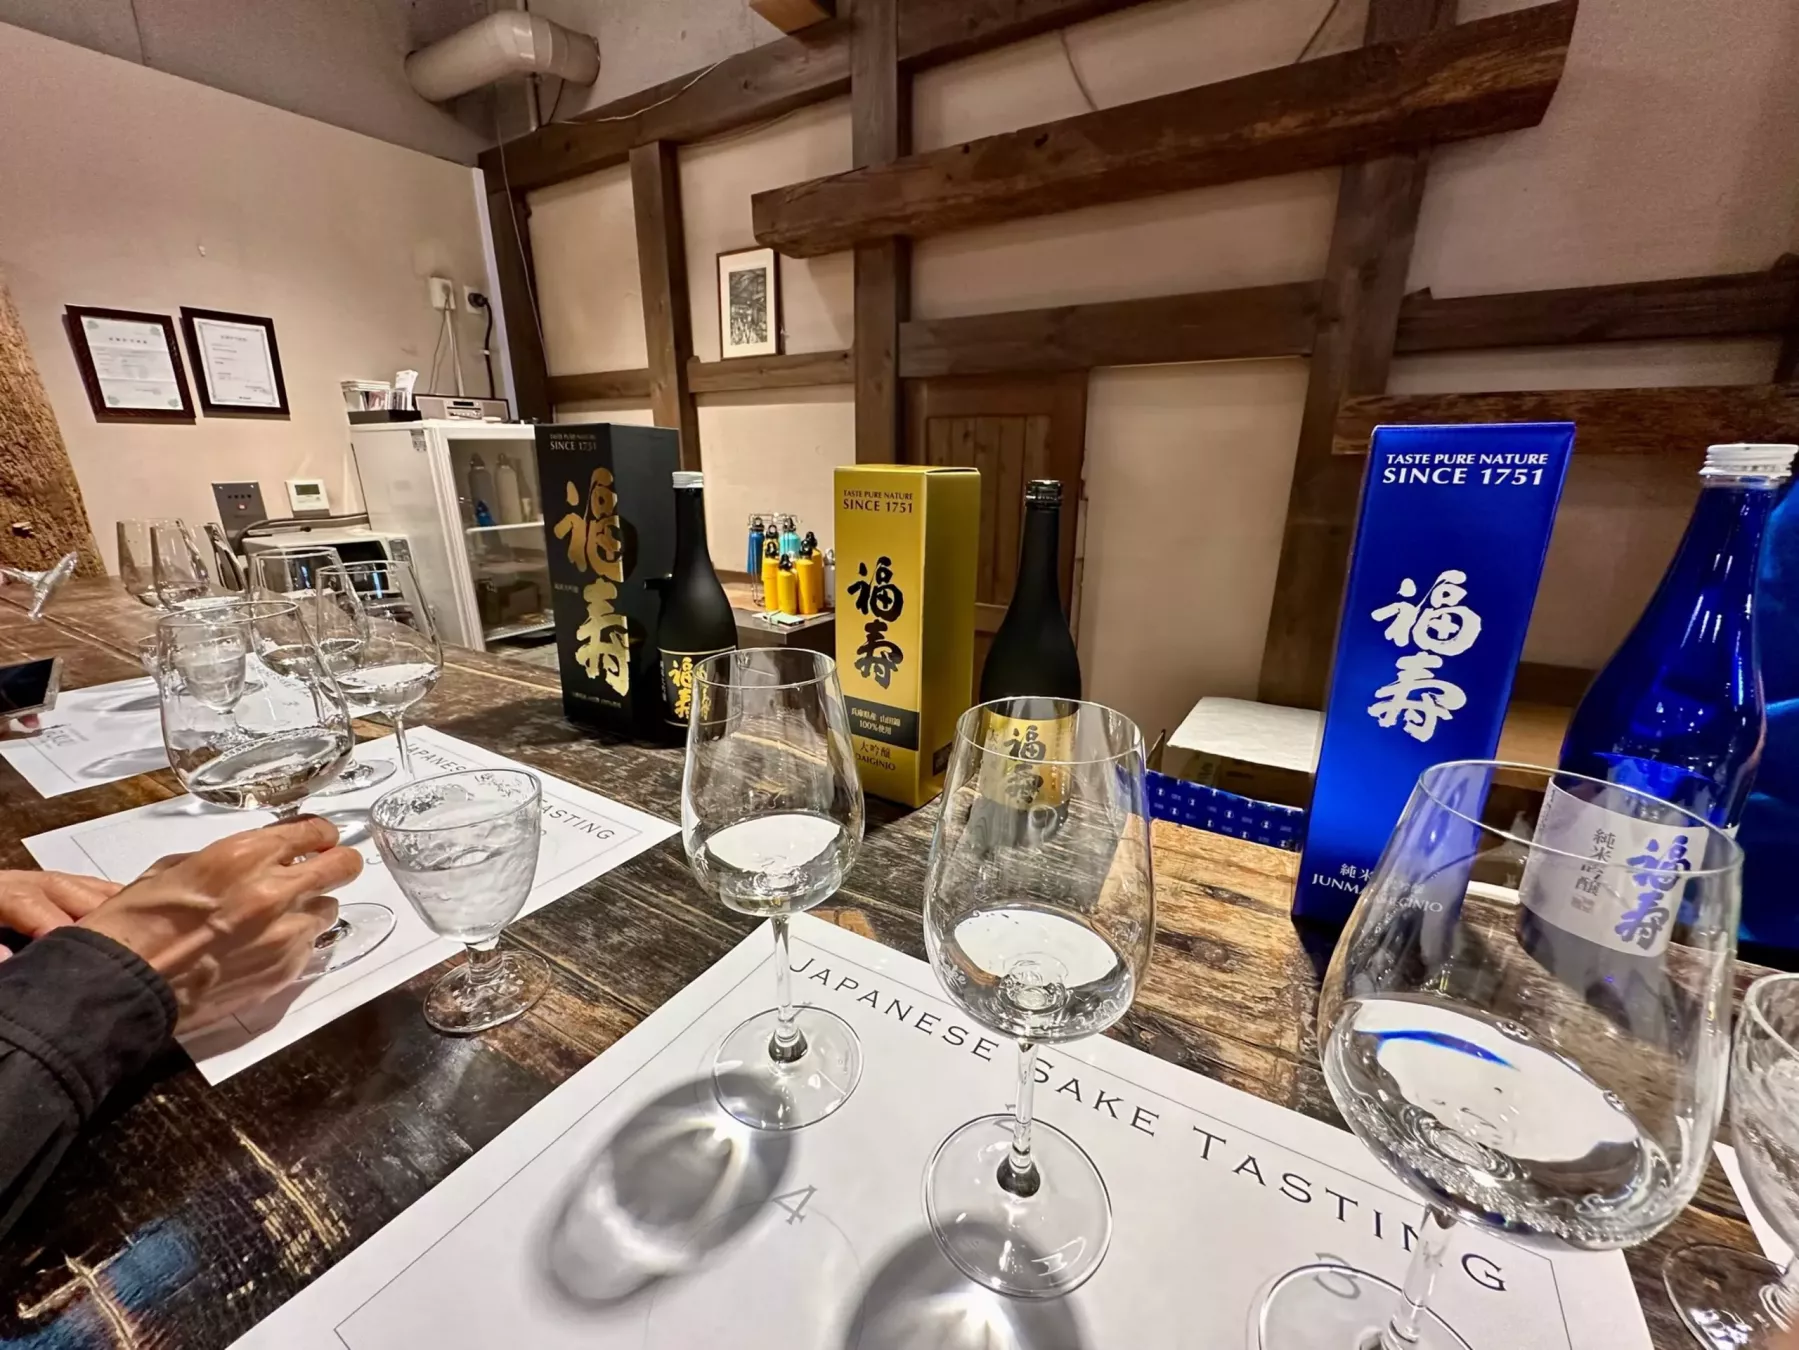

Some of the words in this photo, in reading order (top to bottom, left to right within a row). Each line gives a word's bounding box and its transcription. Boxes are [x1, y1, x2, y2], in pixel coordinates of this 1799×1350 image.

[550, 441, 576, 451] SINCE
[1386, 453, 1431, 465] TASTE
[1434, 453, 1476, 465] PURE
[1479, 453, 1549, 465] NATURE
[1382, 467, 1468, 485] SINCE
[1480, 468, 1544, 486] 1751
[843, 489, 863, 498] TASTE
[864, 491, 882, 499] PURE
[883, 492, 913, 501] NATURE
[843, 498, 880, 512] SINCE
[886, 501, 913, 514] 1751
[847, 556, 904, 689] 福寿
[1367, 569, 1482, 743] 福寿
[789, 957, 1000, 1062] JAPANESE
[1033, 1056, 1160, 1138] SAKE
[771, 1184, 818, 1226] 4
